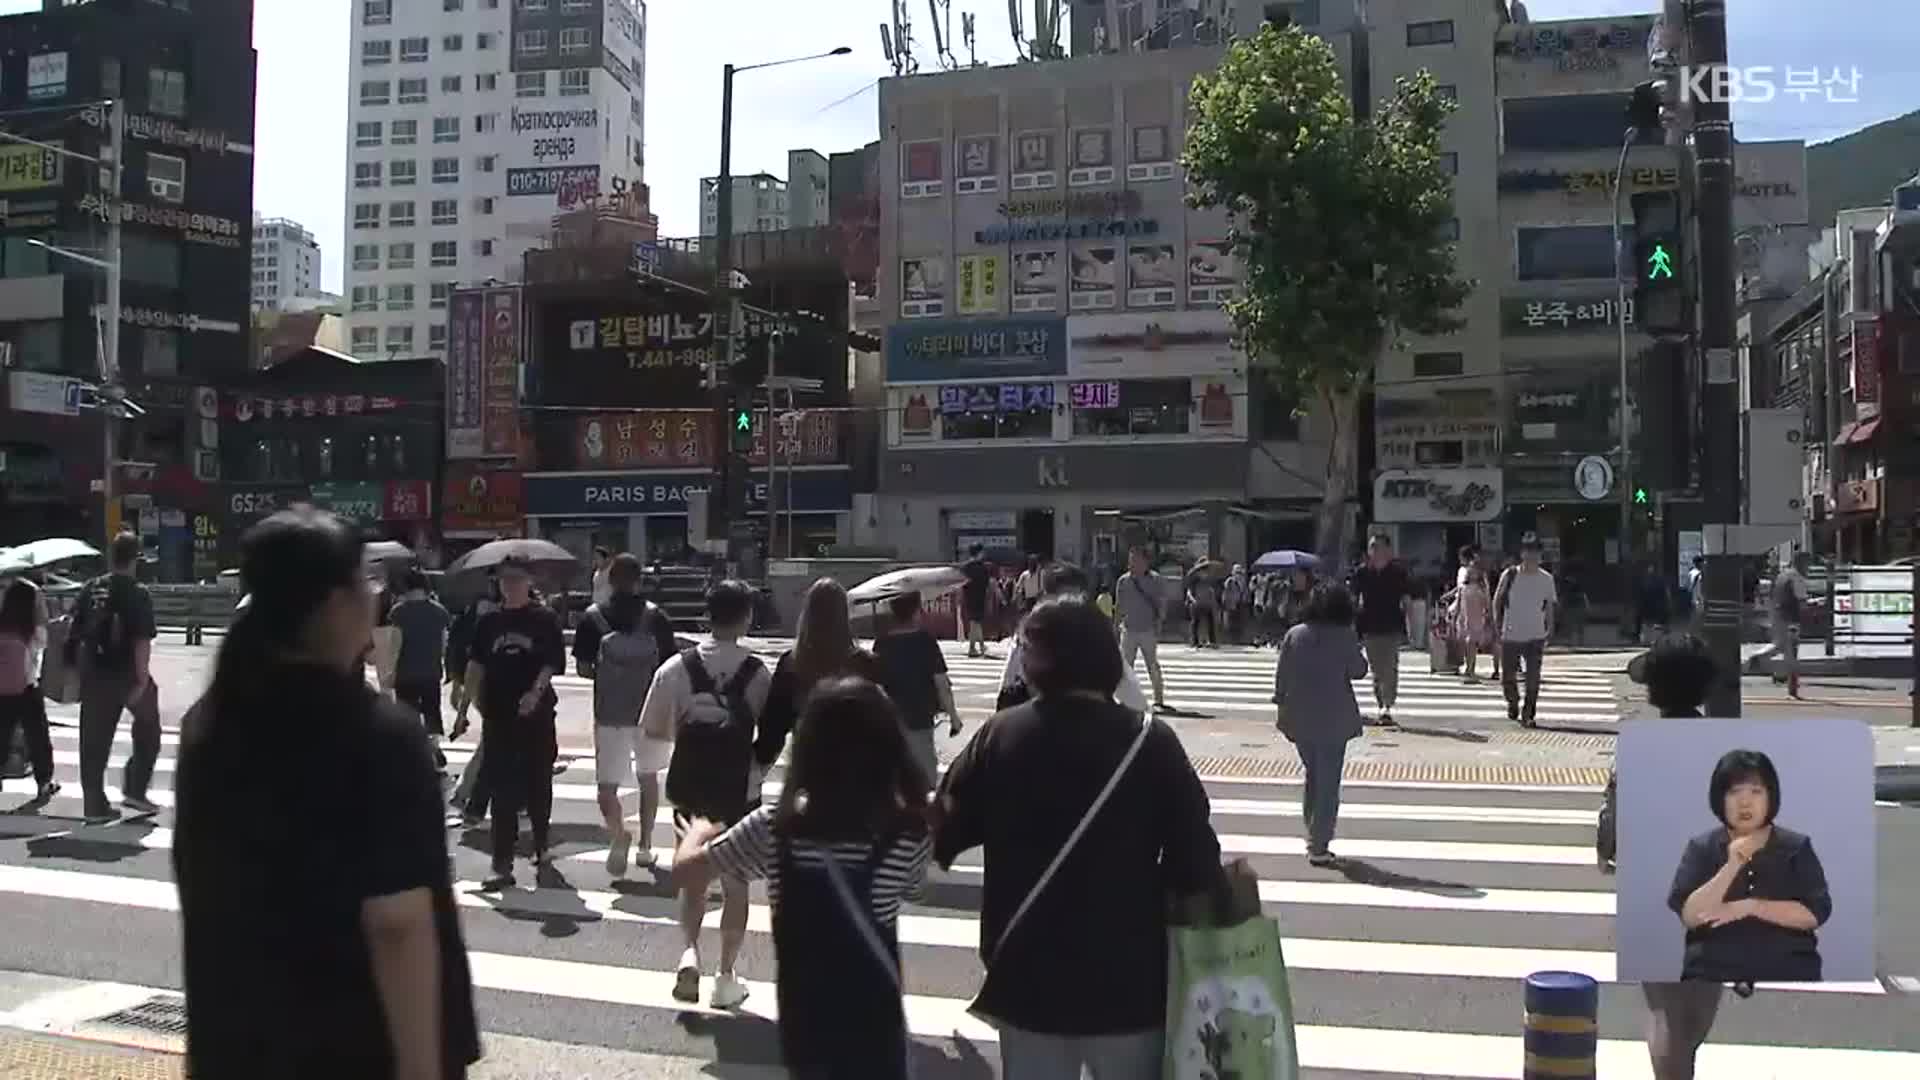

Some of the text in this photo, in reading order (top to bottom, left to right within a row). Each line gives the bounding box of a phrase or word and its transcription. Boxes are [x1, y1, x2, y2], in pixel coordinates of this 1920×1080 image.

[511, 105, 598, 134] Краткосрочная
[533, 136, 576, 162] аренда
[1738, 183, 1796, 197] OTEL
[938, 383, 1054, 413] 맘스터치
[616, 415, 698, 440] 남성수
[231, 491, 276, 513] GS25
[584, 486, 646, 503] PARIS
